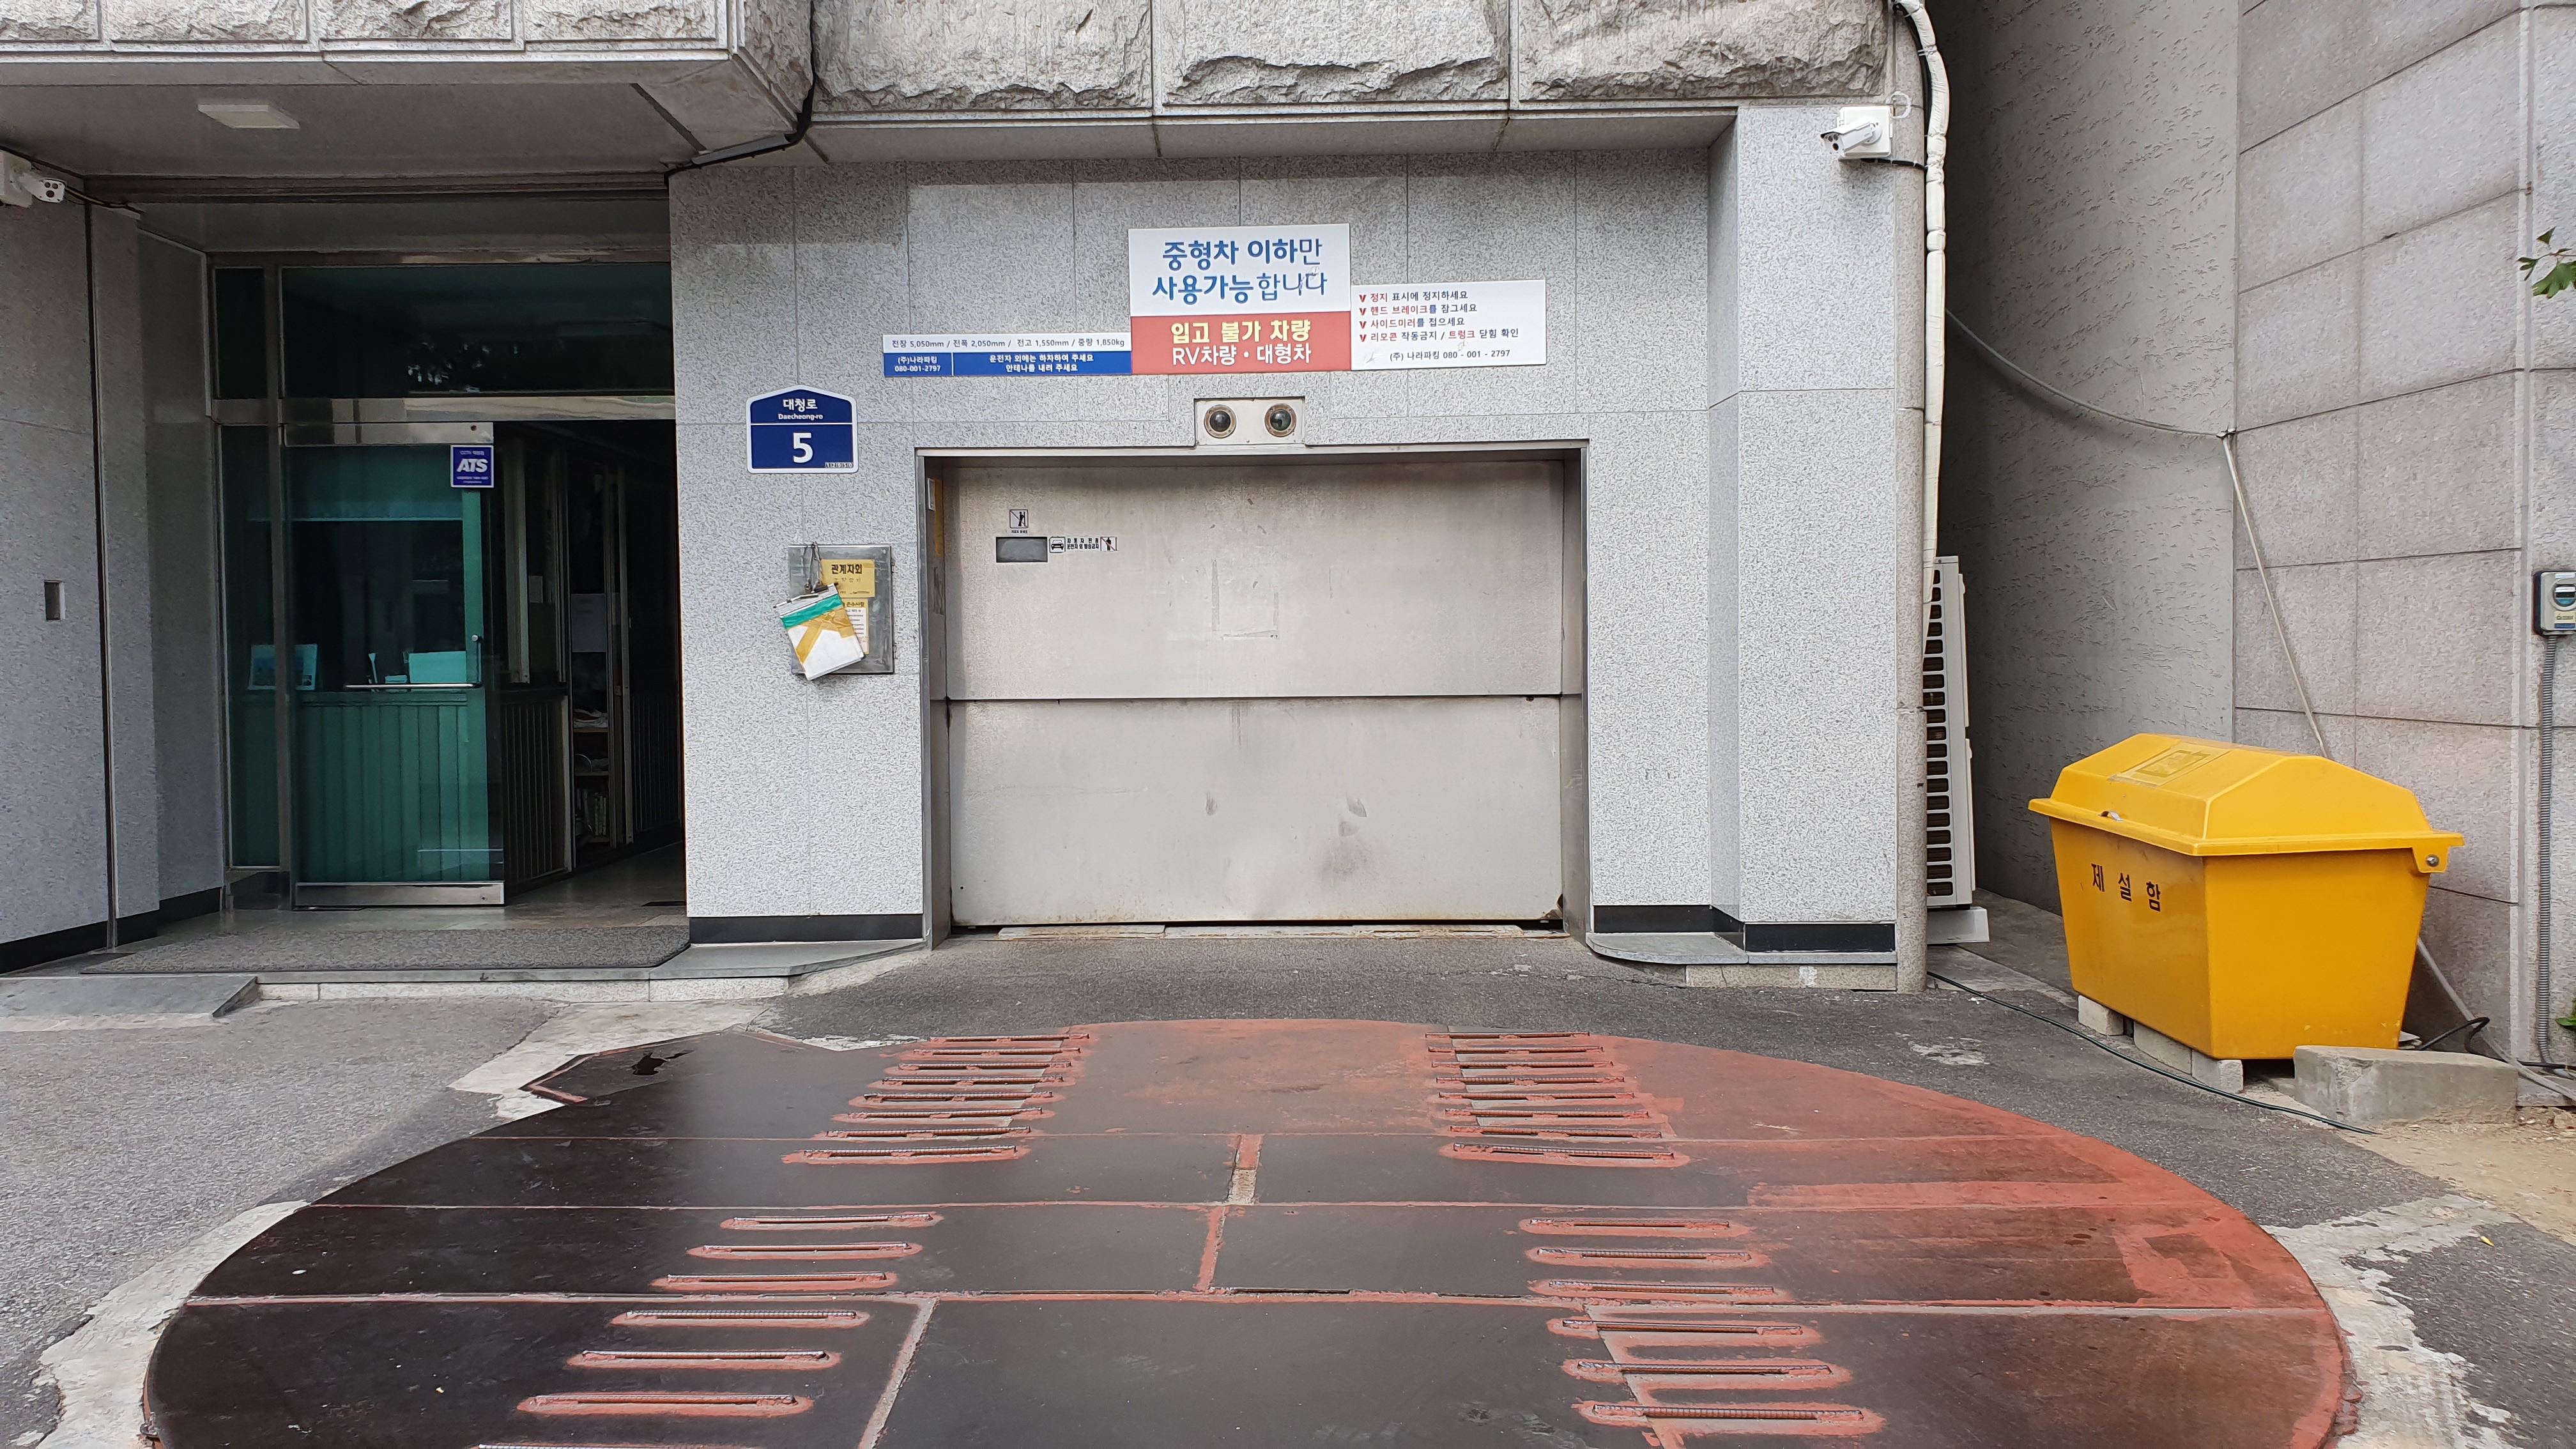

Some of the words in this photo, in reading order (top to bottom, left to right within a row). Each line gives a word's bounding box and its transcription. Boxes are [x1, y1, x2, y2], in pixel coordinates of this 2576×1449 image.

[1163, 240, 1239, 272] 중형차
[1247, 238, 1322, 265] 이하만
[1152, 272, 1328, 305] 사용가능합니다
[1370, 293, 1388, 302] 정지
[1392, 291, 1419, 302] 표시에
[1422, 291, 1468, 301] 정지하세요
[1370, 306, 1388, 316] 핸드
[1392, 305, 1437, 315] 브레이크를
[1441, 303, 1477, 314] 잠그세요
[1370, 318, 1425, 328] 사이드미러를
[1429, 317, 1465, 326] 접으세요
[1171, 322, 1210, 344] 입고
[1221, 321, 1261, 343] 불가
[1269, 319, 1311, 342] 차량
[1370, 332, 1397, 342] 리모콘
[1401, 330, 1438, 341] 작동금지
[1448, 330, 1476, 340] 트렁크
[1479, 329, 1497, 339] 닫힘
[1501, 328, 1519, 338] 확인
[892, 340, 907, 348] 전장
[910, 341, 944, 349] 5,050mm
[971, 340, 1006, 348] 2,050mm
[1078, 338, 1093, 347] 중량
[1096, 339, 1125, 347] 1,850kg
[898, 356, 937, 364] (주)나라파킹
[989, 355, 1012, 363] 운전자
[1014, 354, 1037, 363] 외에는
[1039, 353, 1070, 362] 하차하여
[1071, 353, 1094, 362] 주세요
[1172, 344, 1238, 366] RV차량
[1257, 343, 1312, 364] 대형차
[1390, 352, 1404, 361] (주)
[1407, 350, 1440, 360] 나라파킹
[1006, 364, 1036, 372] 안테나를
[1038, 364, 1053, 372] 내려
[1055, 364, 1078, 372] 주세요
[783, 398, 818, 413] 대청로
[793, 433, 813, 463] 5
[456, 458, 489, 473] ATS
[831, 564, 862, 574] 관계자외
[2091, 863, 2161, 912] 제설함
